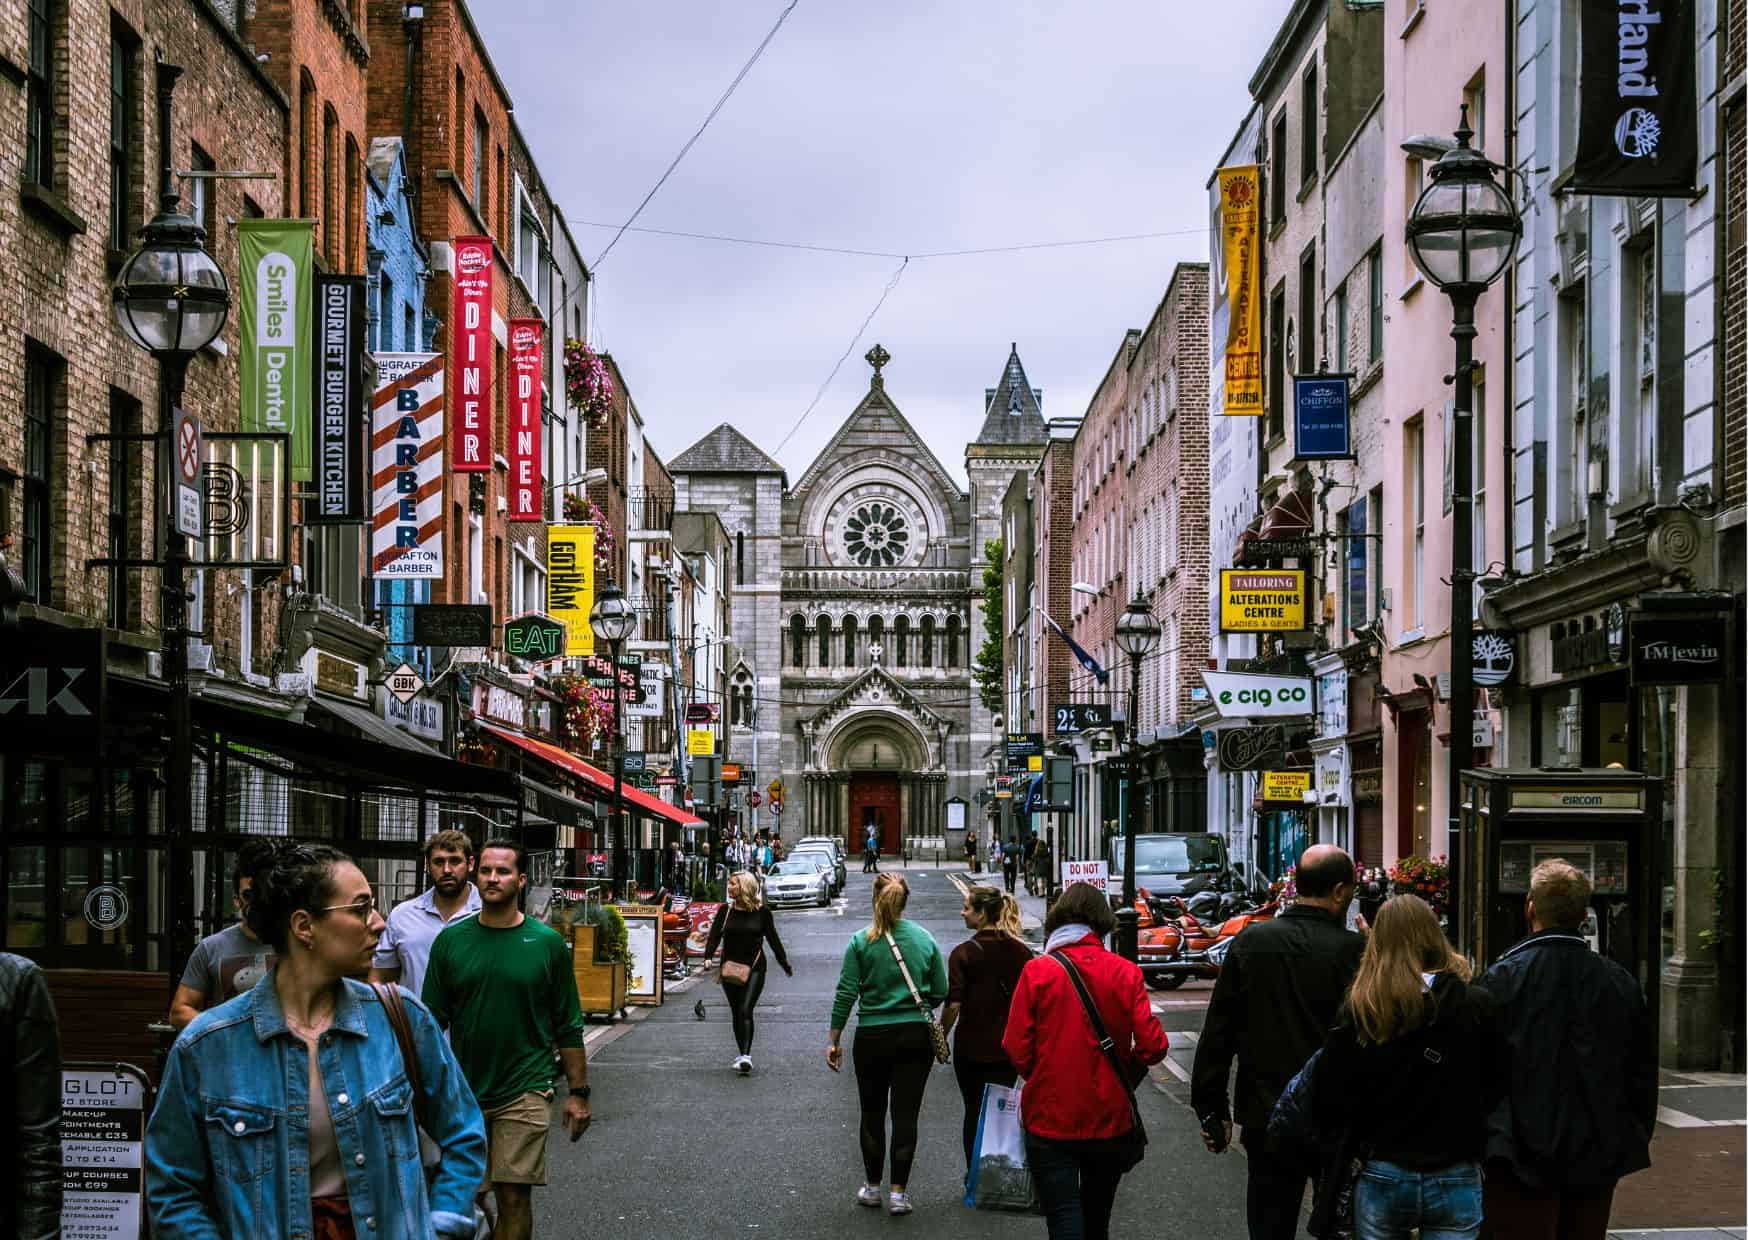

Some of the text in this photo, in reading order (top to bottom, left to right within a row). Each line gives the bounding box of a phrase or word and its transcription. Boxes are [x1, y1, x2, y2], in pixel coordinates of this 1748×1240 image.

[266, 264, 287, 338] Smiles
[388, 360, 439, 370] GRAFTON
[390, 373, 433, 383] BARBER
[464, 302, 480, 462] DINER
[266, 352, 287, 430] Dental
[326, 283, 346, 516] GOURMET BURGER KITCHEN
[519, 375, 532, 513] DINER
[396, 389, 419, 548] BARBER
[387, 551, 437, 561] GRAFTON
[388, 564, 433, 573] BARBER
[550, 541, 591, 610] GOTHAM
[1236, 578, 1294, 588] TAILORING
[1230, 594, 1301, 605] ALTERATIONS
[1244, 607, 1285, 617] CENTRE
[507, 625, 561, 655] EAT
[394, 677, 416, 689] GBK
[1219, 686, 1307, 707] e cig co
[1562, 794, 1603, 806] eircom
[1070, 863, 1099, 875] DO NOT
[1088, 878, 1106, 889] THIS
[83, 1171, 129, 1179] COURSES
